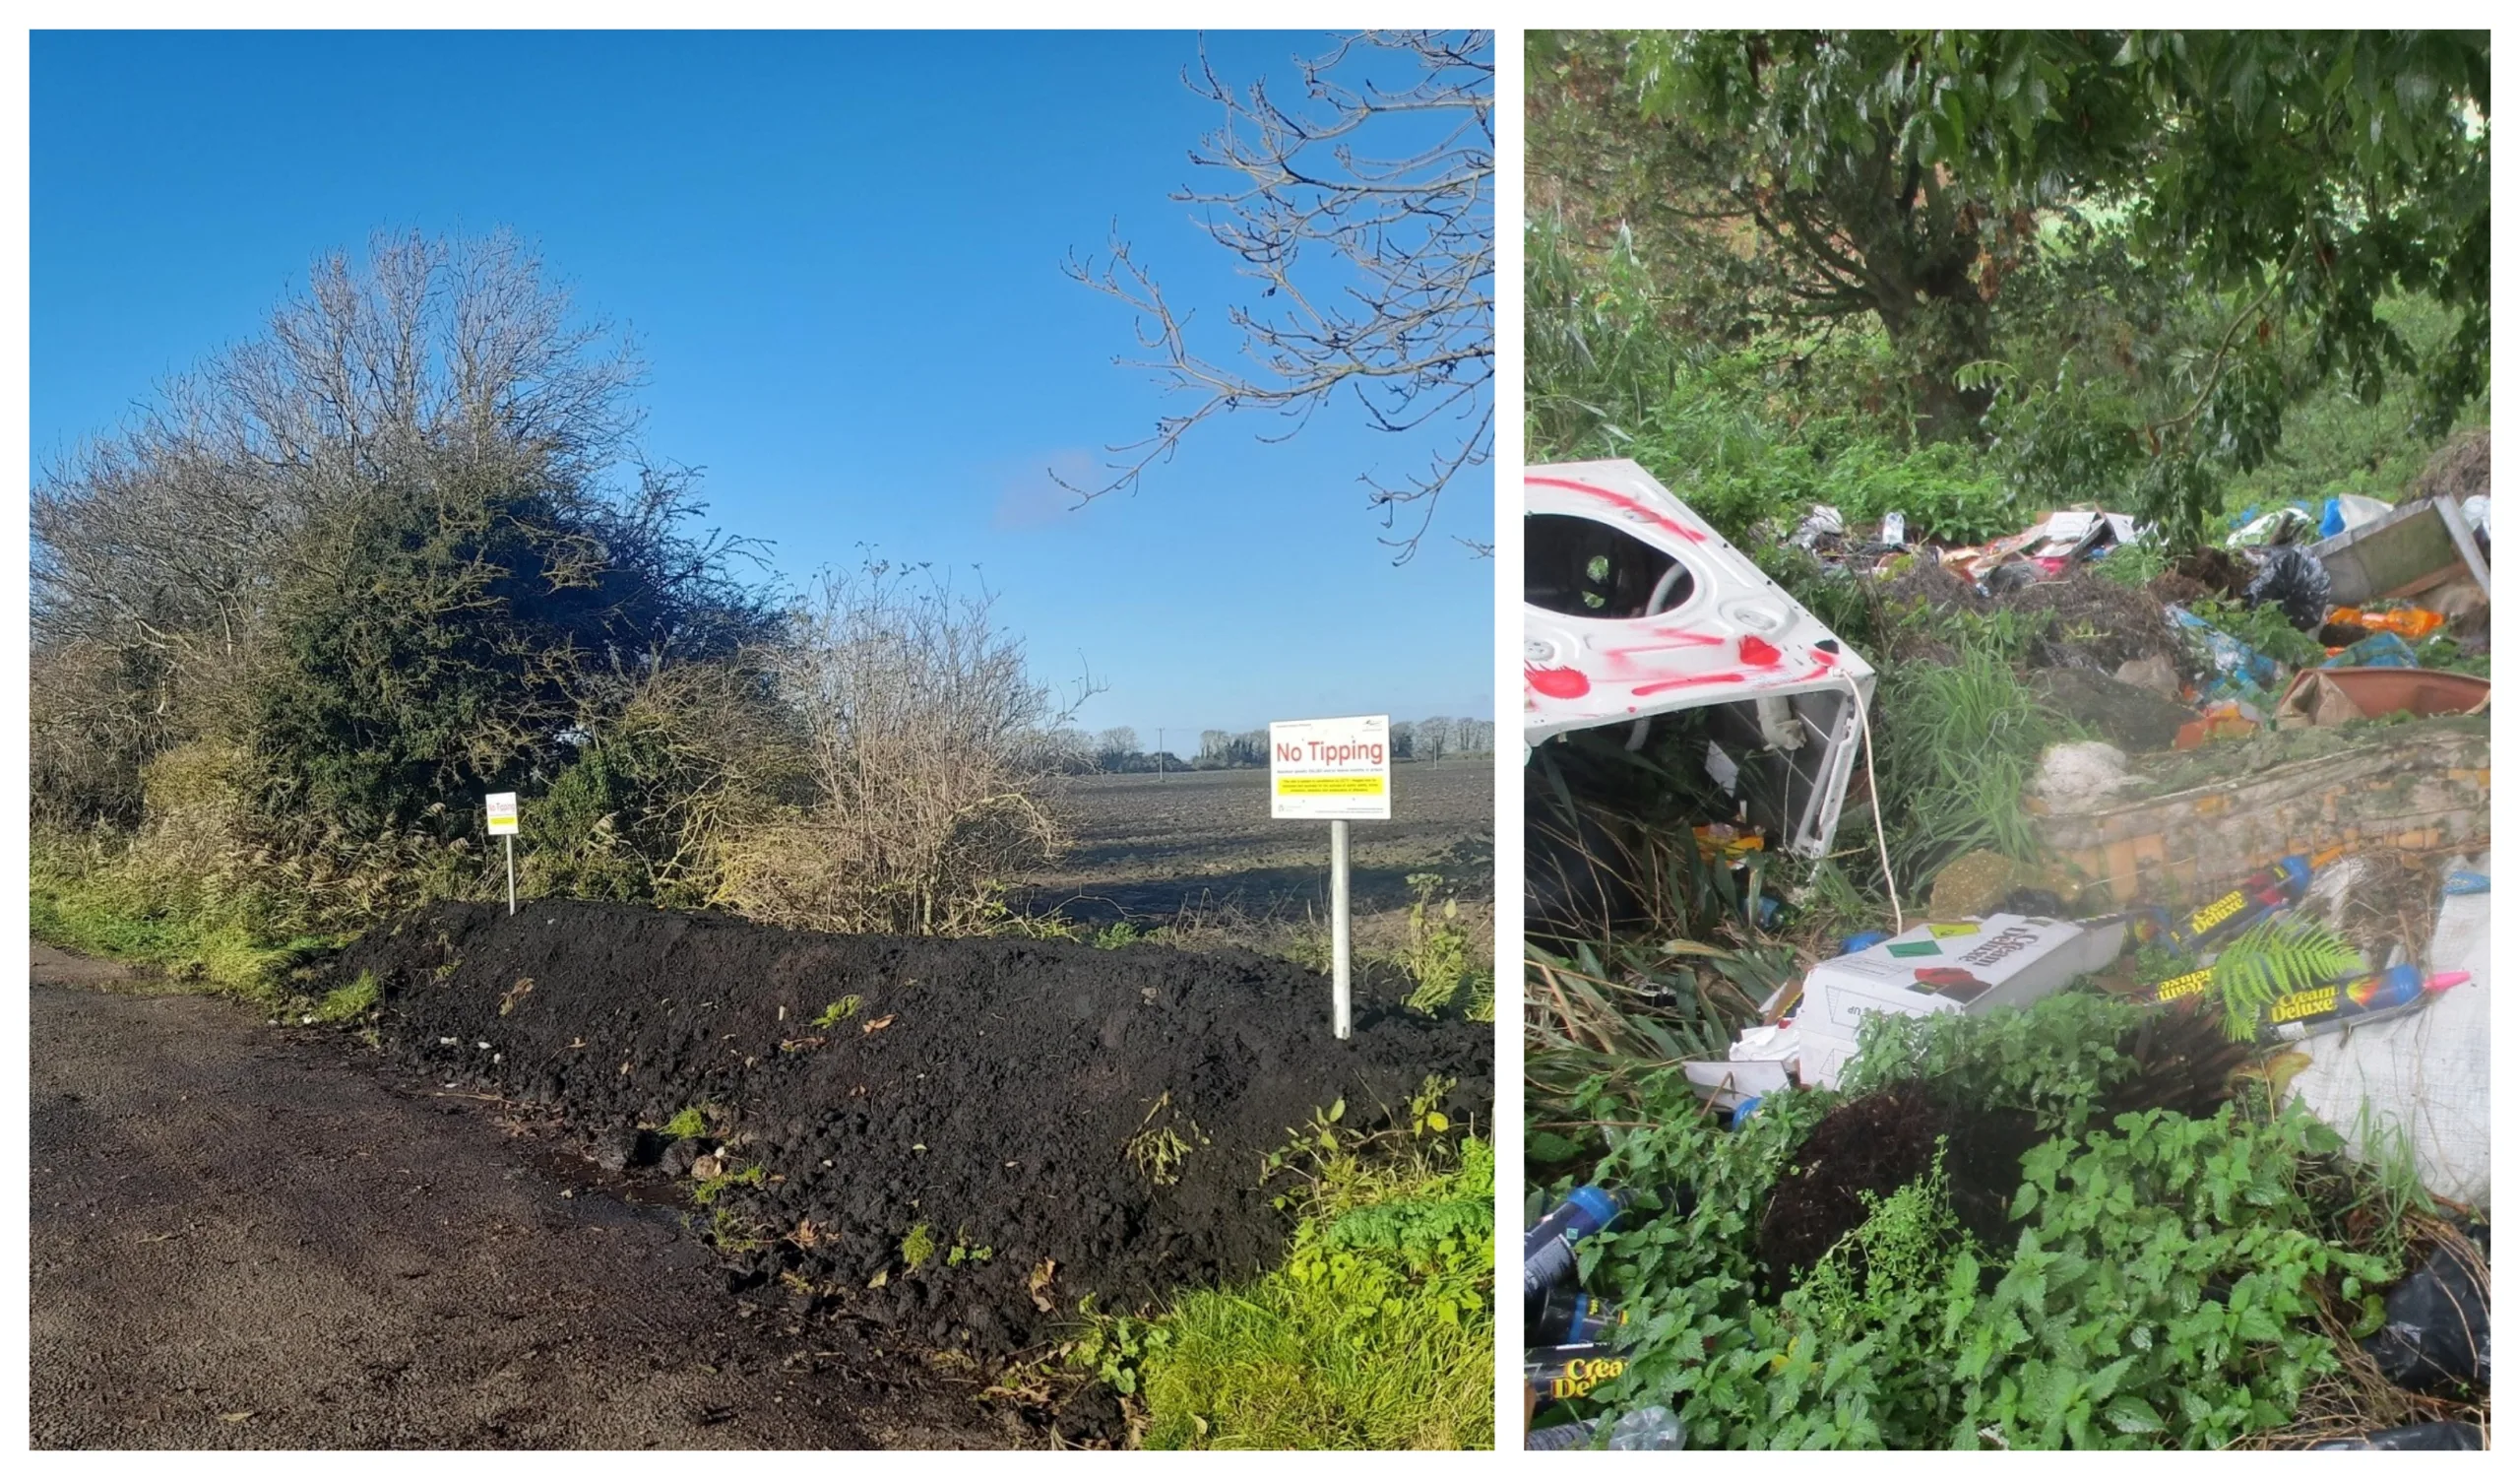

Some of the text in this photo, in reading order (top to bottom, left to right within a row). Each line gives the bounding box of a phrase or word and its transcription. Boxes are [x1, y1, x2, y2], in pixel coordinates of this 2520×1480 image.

[1276, 740, 1383, 766] No Tipping
[2191, 898, 2244, 934] Deluxe
[2193, 890, 2241, 920] Cream
[1958, 927, 2030, 962] Deluxe
[1973, 934, 2039, 967] Cream
[2159, 978, 2212, 1002] ream
[2278, 986, 2335, 1006] Cream
[1847, 1005, 1861, 1016] UP
[2270, 997, 2334, 1023] Deluxe
[1566, 1358, 1625, 1381] Crea
